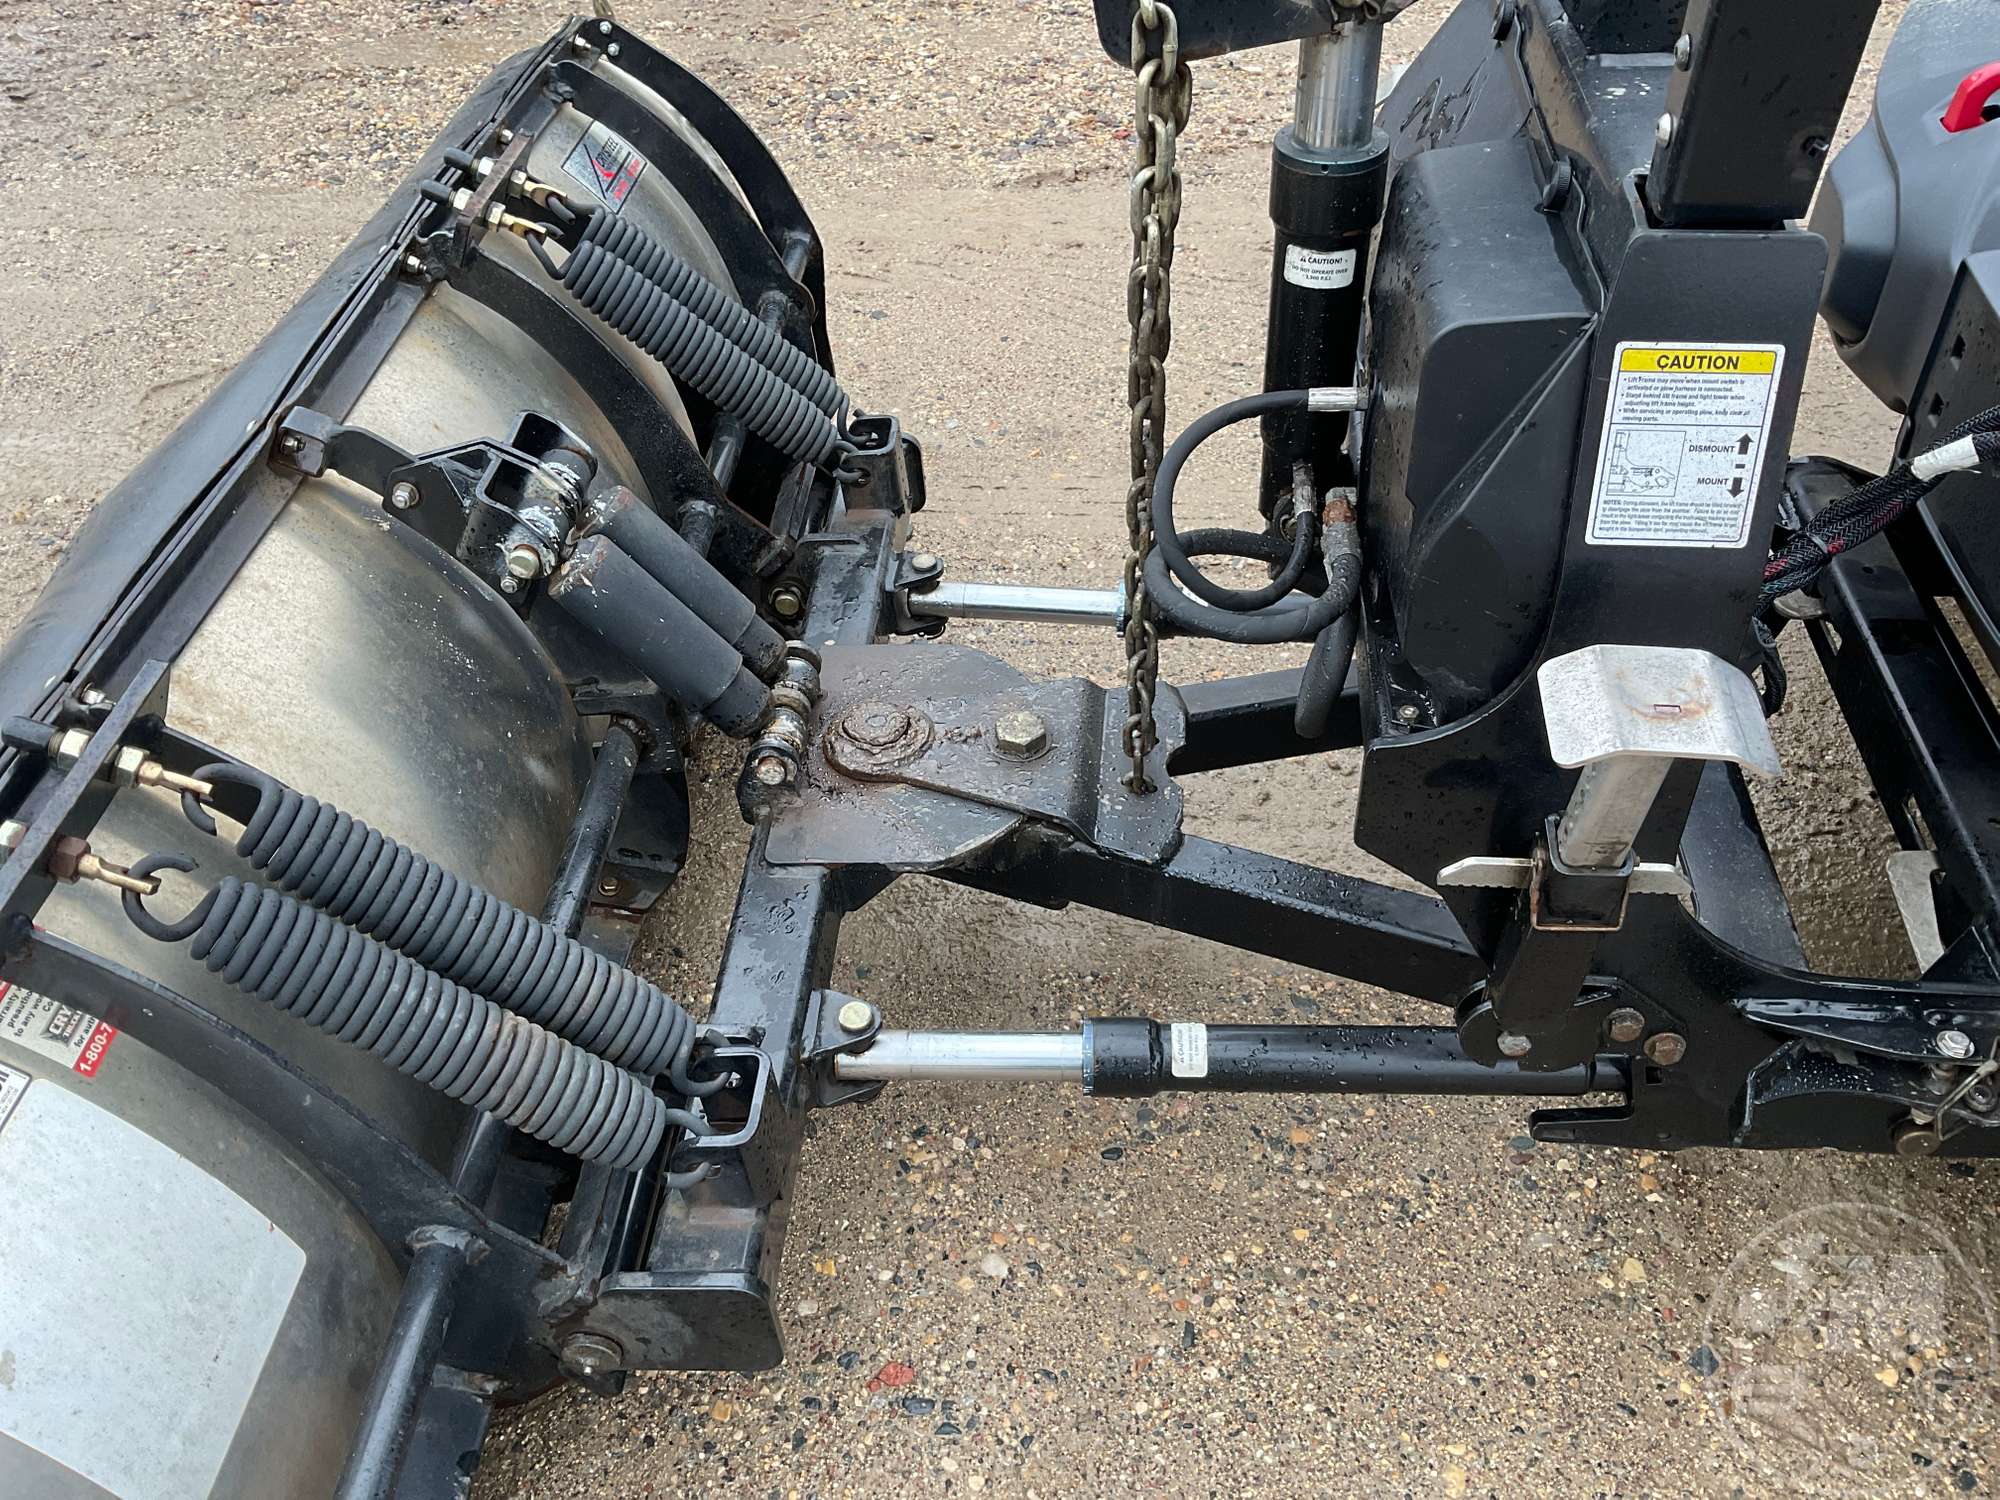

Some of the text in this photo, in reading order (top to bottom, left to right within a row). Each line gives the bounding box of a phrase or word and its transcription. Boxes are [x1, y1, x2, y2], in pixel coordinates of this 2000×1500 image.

[1308, 257, 1343, 265] CAUTION!
[1656, 354, 1740, 370] CAUTION
[1688, 445, 1736, 453] DISMOUNT
[13, 1027, 24, 1037] to
[21, 1011, 36, 1027] any
[73, 1034, 86, 1048] for
